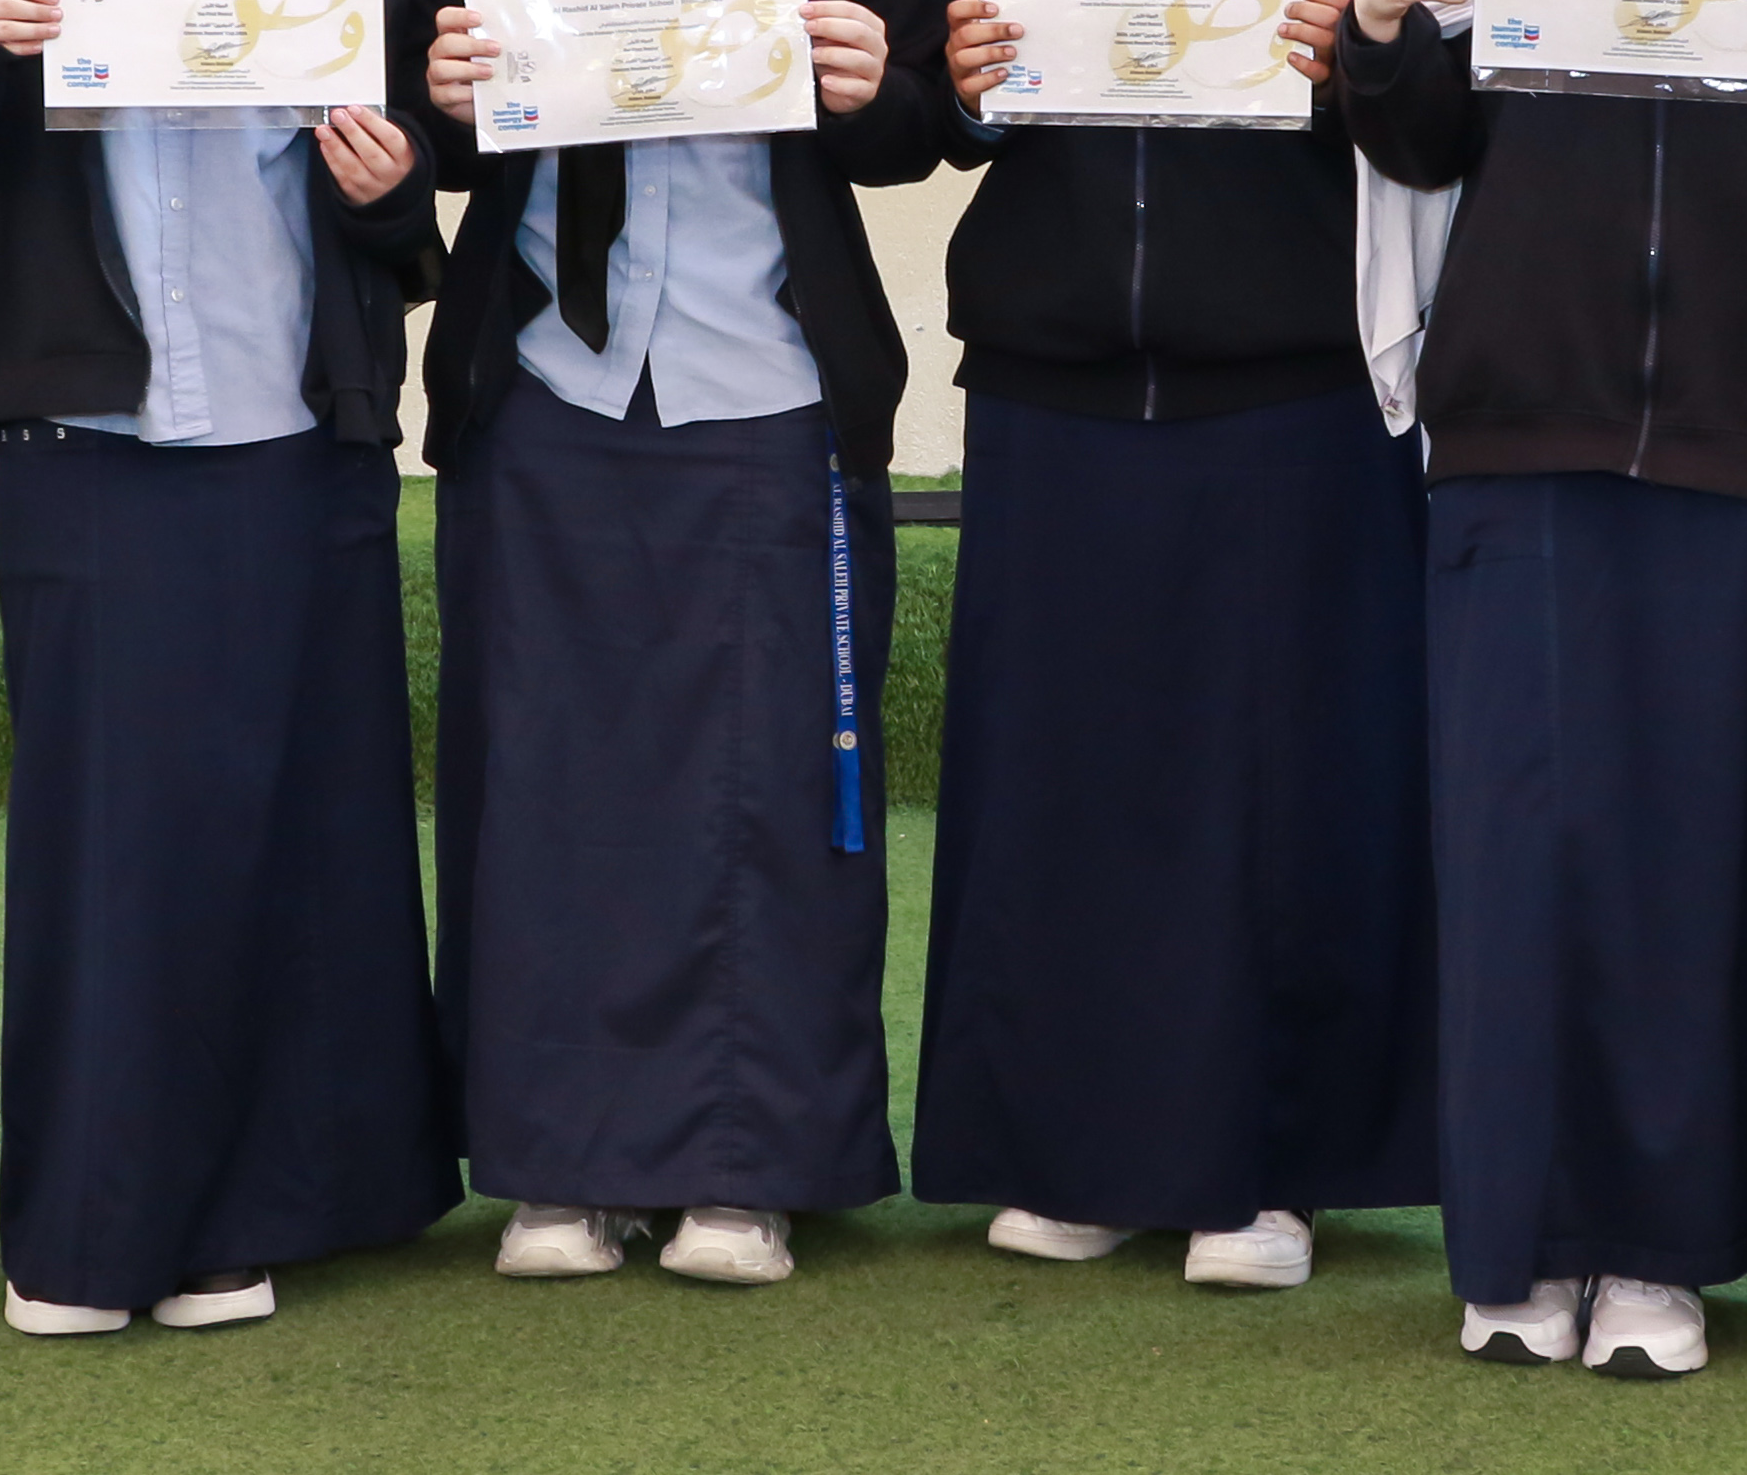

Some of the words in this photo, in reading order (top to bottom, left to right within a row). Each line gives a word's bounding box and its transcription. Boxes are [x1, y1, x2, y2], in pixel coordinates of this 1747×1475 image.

[834, 538, 846, 552] AL
[834, 553, 849, 588] SALEH
[834, 588, 850, 633] PRIVATE
[837, 634, 853, 677] SCHOOL
[840, 684, 854, 717] DUBAI
